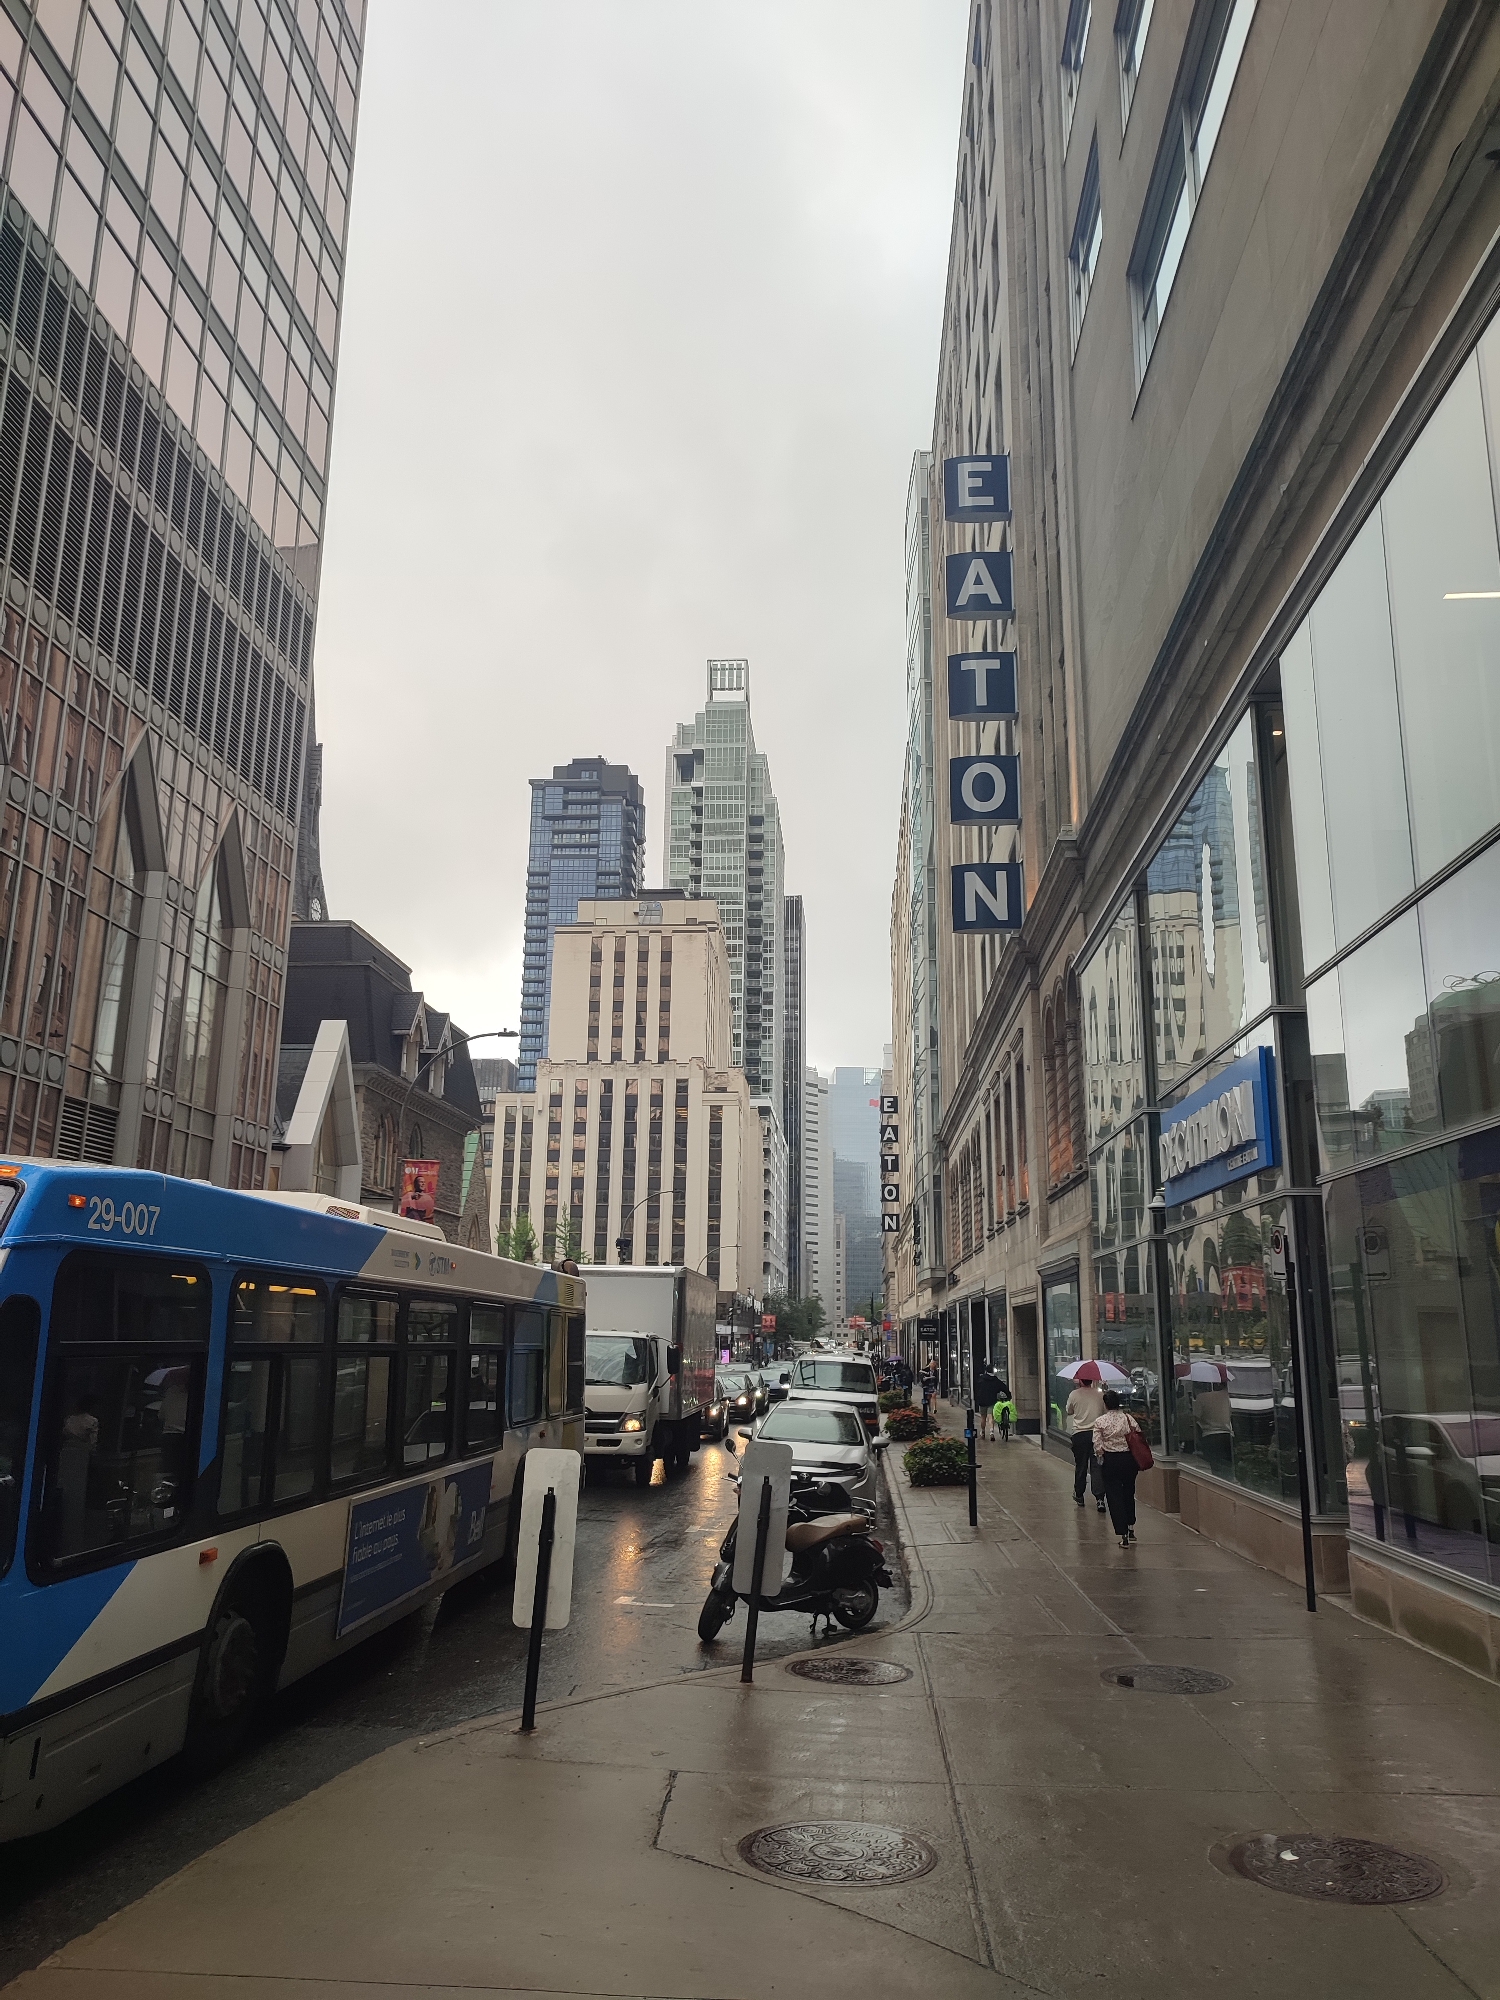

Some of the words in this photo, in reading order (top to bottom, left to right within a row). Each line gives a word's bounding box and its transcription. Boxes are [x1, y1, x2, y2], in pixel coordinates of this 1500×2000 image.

[955, 462, 1008, 922] EATON
[883, 1097, 897, 1230] EATON
[1159, 1080, 1257, 1183] DECATHLON
[88, 1195, 161, 1236] 29-007
[467, 1506, 486, 1545] Bell
